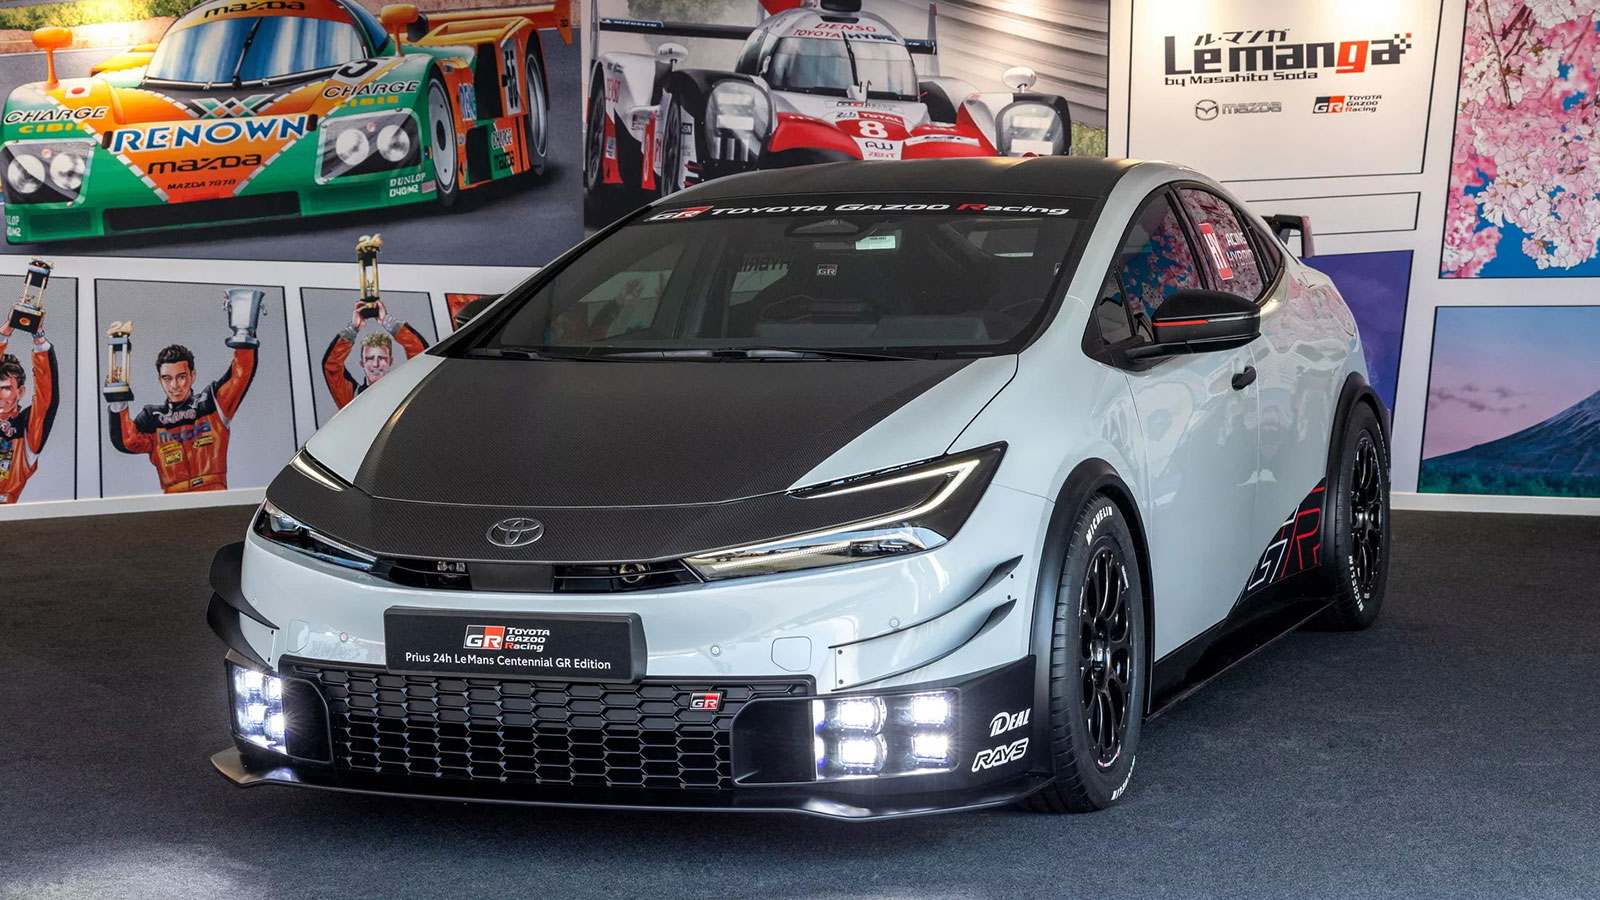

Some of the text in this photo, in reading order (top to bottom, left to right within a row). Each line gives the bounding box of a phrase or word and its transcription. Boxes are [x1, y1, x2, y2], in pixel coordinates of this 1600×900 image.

[793, 29, 841, 38] TOYOTA
[815, 23, 877, 33] DENSO
[1165, 70, 1318, 87] by Masahito Soda
[323, 81, 420, 98] CHARGE
[1313, 100, 1344, 113] GR
[4, 107, 108, 124] CHARGE
[862, 112, 903, 123] TOTAL
[111, 114, 308, 153] RENOWN
[858, 121, 889, 139] 8
[167, 179, 206, 190] MAZDA
[390, 173, 426, 187] DUNLOP
[712, 206, 828, 215] TOYOTA
[835, 203, 950, 211] GAZOO
[957, 203, 1070, 215] Racing
[1086, 505, 1113, 546] MICHELIN
[506, 627, 550, 636] TOYOTA
[465, 631, 503, 649] GR
[505, 635, 546, 643] GAZOO
[504, 642, 544, 652] Racing
[405, 652, 431, 662] Prius
[433, 653, 452, 664] 24h
[497, 655, 553, 668] Centennial
[555, 658, 572, 668] GR
[574, 658, 611, 670] Edition
[691, 697, 718, 709] GR
[971, 737, 1029, 773] RAYS
